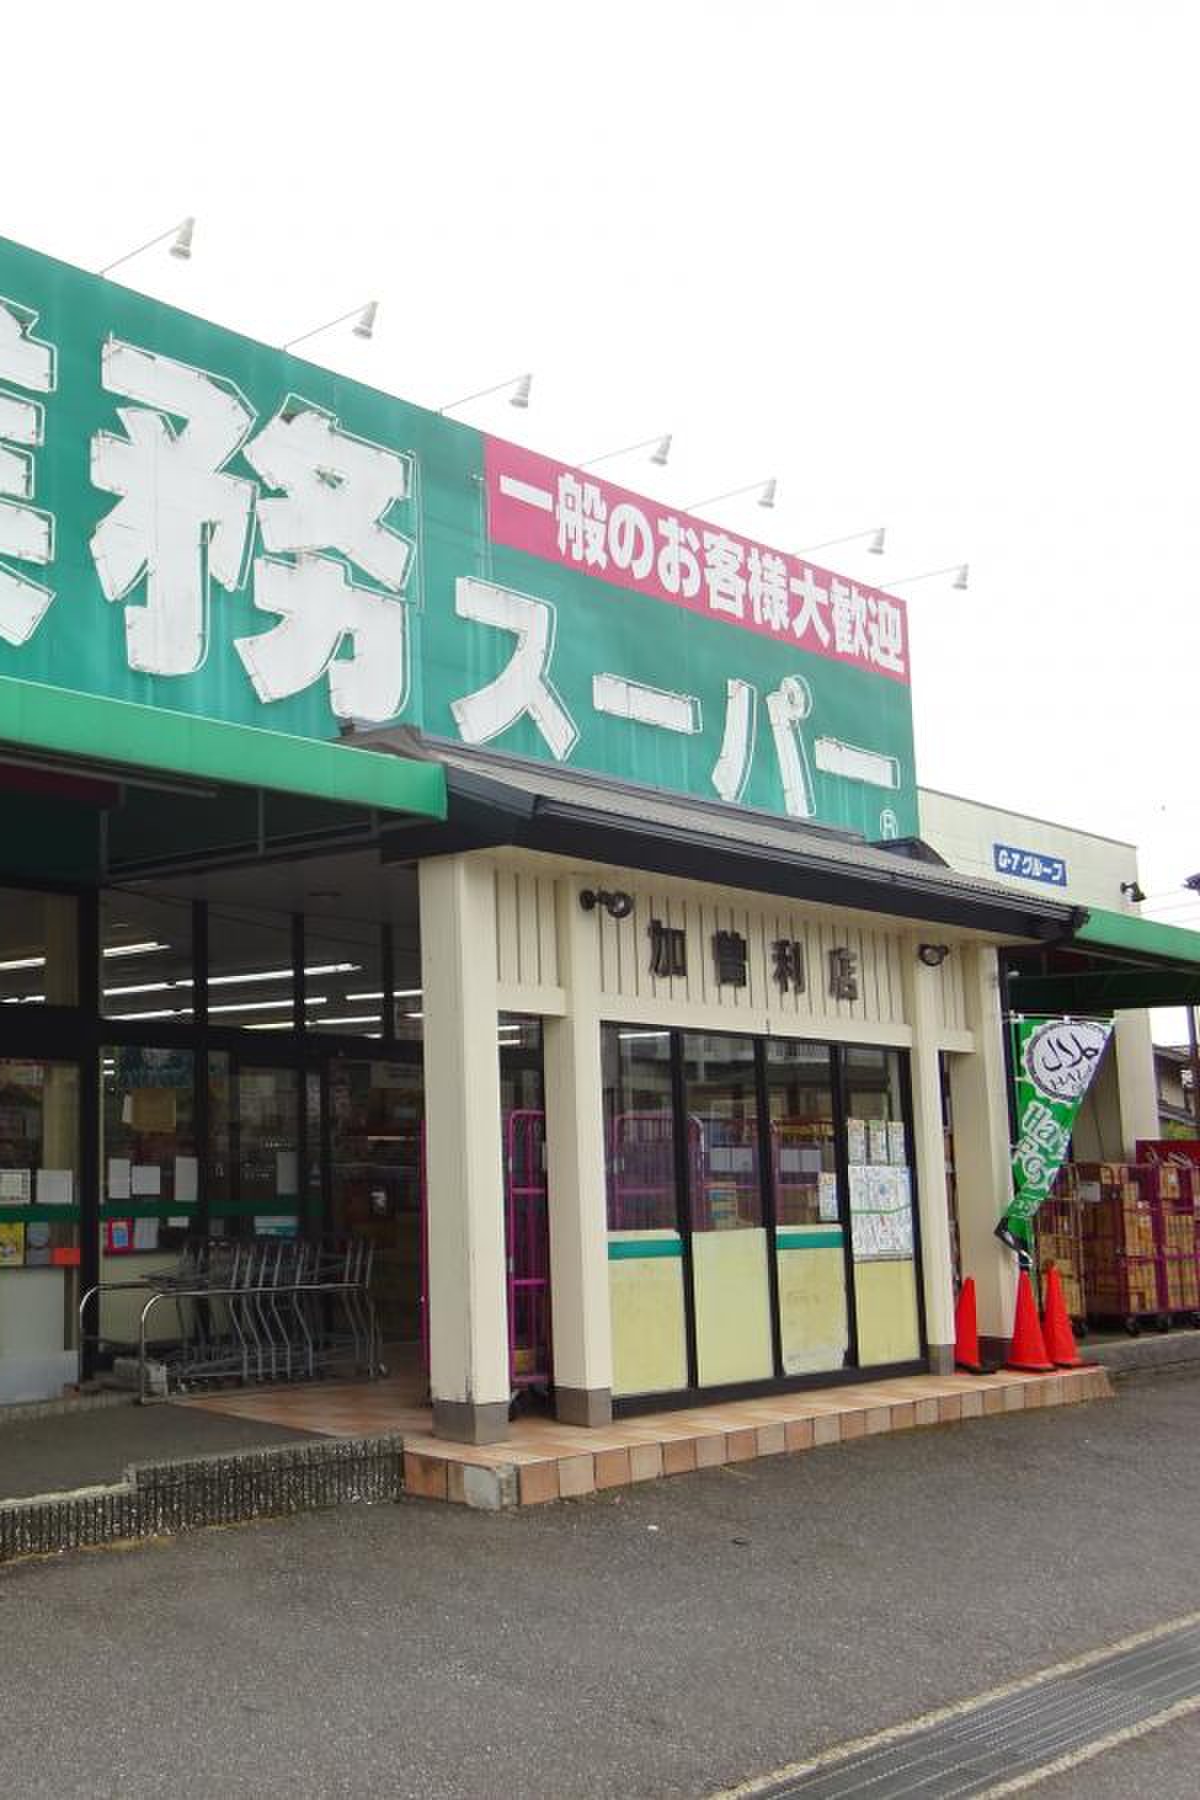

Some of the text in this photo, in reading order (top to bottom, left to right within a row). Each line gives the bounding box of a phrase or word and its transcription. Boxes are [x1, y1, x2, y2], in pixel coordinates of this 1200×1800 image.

[499, 472, 905, 673] 一般のお客様大歓迎
